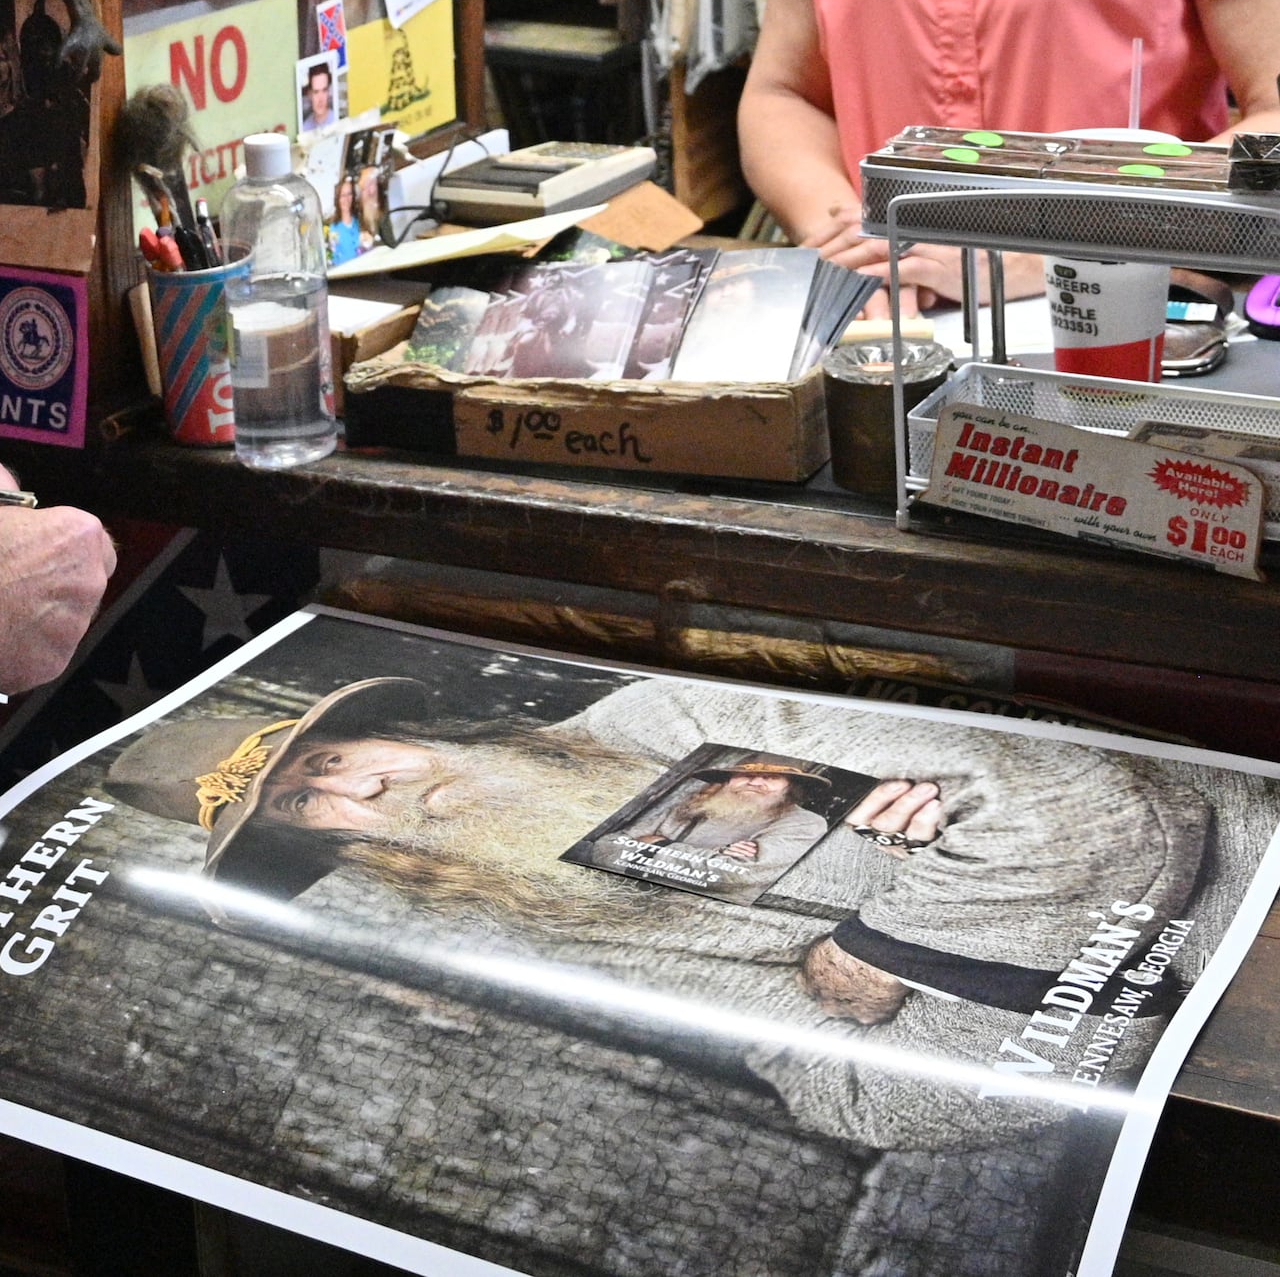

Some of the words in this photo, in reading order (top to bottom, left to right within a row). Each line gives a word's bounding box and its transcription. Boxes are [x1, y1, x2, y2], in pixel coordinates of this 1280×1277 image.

[170, 24, 249, 112] NO
[1051, 302, 1097, 321] WAFFLE
[952, 411, 972, 422] you
[975, 416, 995, 425] can
[997, 416, 1010, 429] be
[564, 423, 652, 464] each
[955, 422, 1080, 474] Instant
[943, 451, 1128, 517] Millionaire
[1165, 466, 1236, 493] Available
[1177, 480, 1219, 499] Here!
[1073, 513, 1100, 531] with
[1102, 522, 1131, 538] your
[1133, 529, 1157, 542] own
[1189, 506, 1230, 523] ONLY
[1209, 545, 1246, 564] EACH
[612, 835, 705, 865] SOUTHERN
[706, 857, 751, 876] GRIT
[618, 849, 721, 883] WILDMAN'S
[666, 872, 709, 888] GEORGIA
[1122, 919, 1196, 988] GEORGIA
